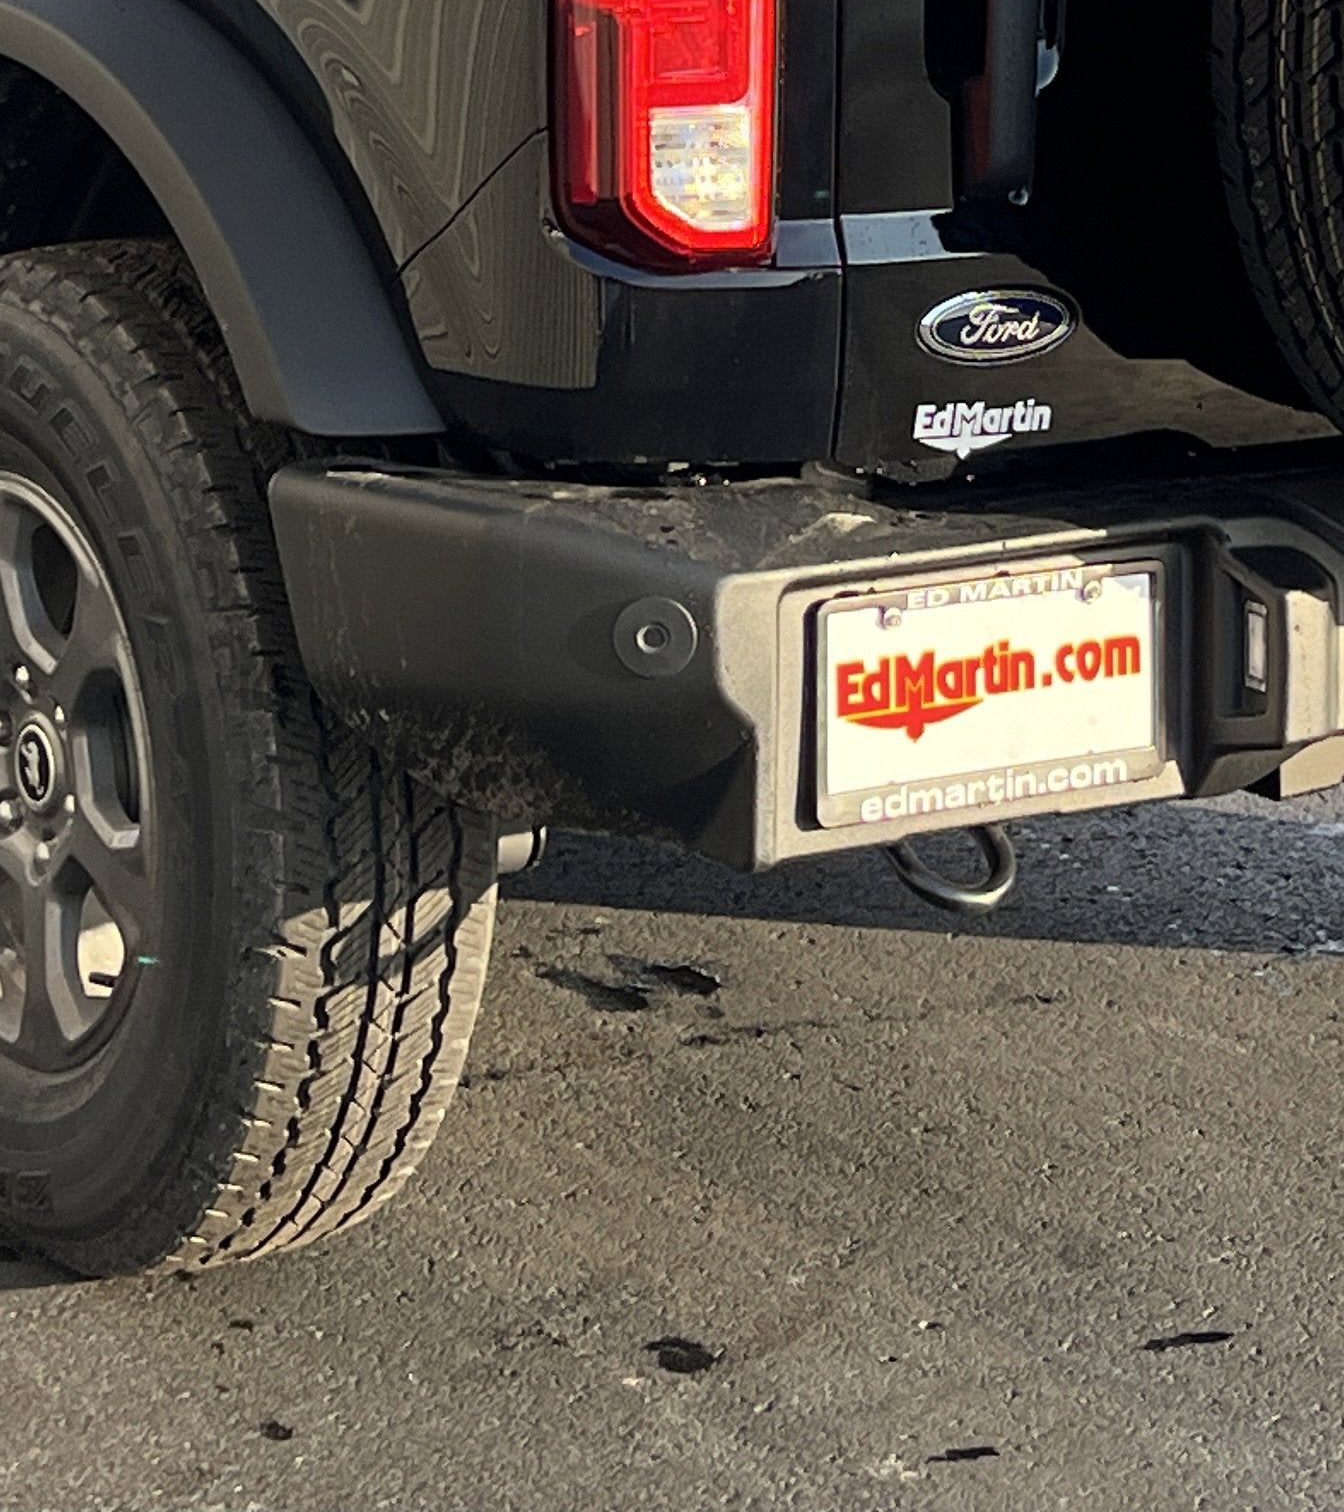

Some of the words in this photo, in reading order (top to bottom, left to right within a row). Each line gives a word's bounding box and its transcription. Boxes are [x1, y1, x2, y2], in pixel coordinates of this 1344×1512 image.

[959, 301, 1041, 347] Ford
[912, 397, 1053, 441] EdMartin
[906, 589, 952, 611] ED
[958, 569, 1085, 605] MARTIN
[860, 756, 1129, 824] edmartin.com
